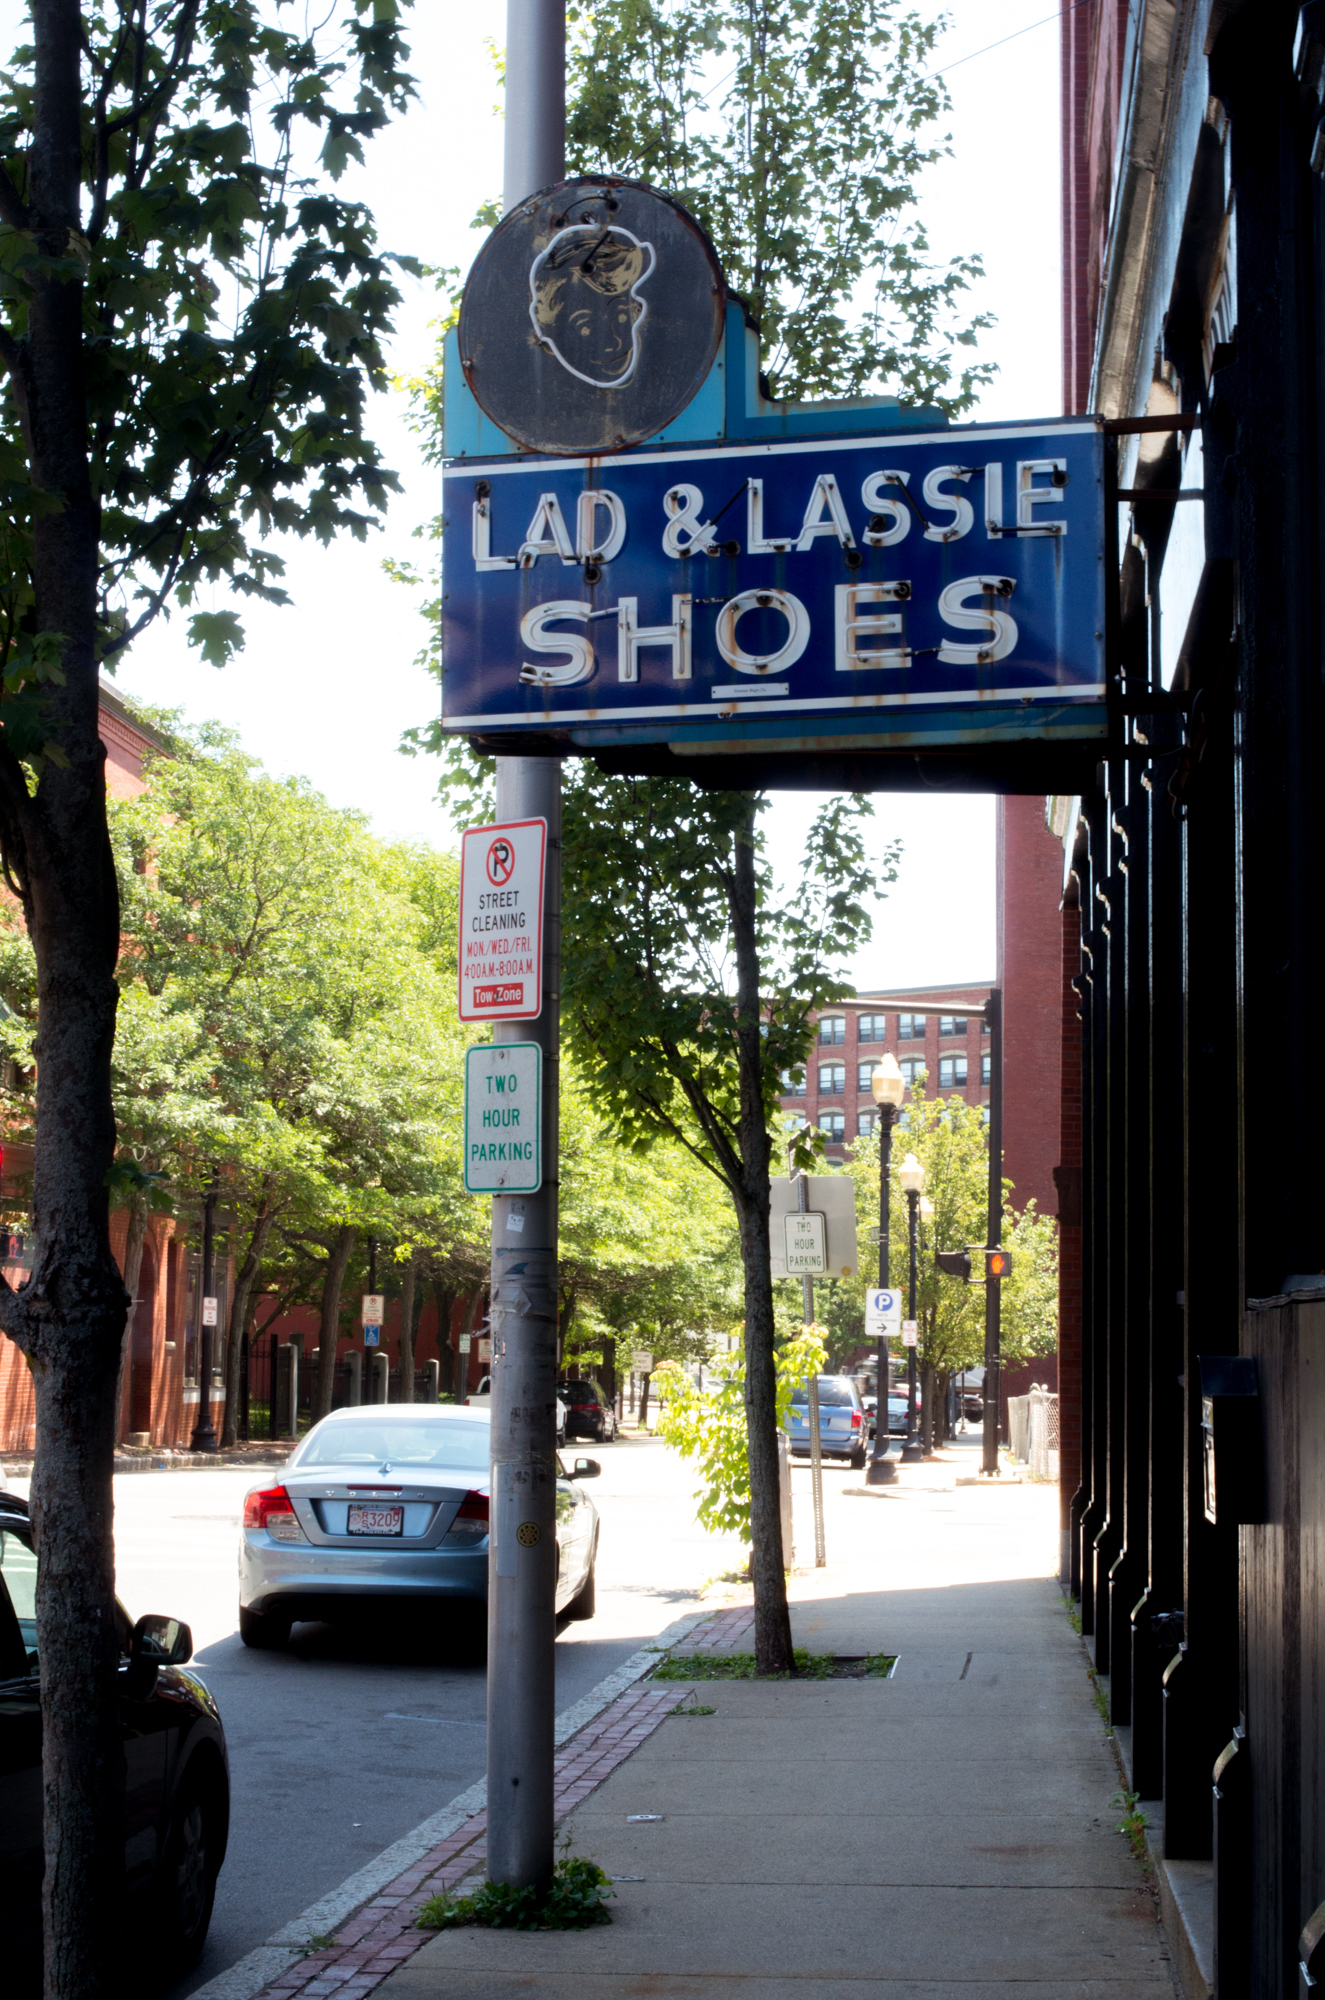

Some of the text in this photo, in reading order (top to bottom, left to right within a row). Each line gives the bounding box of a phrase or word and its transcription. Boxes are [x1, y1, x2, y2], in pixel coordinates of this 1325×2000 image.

[472, 458, 1067, 572] LAD & LASSIE
[519, 575, 1018, 686] SHOES
[479, 890, 519, 909] STREET
[472, 912, 526, 932] CLEANING
[475, 987, 521, 1004] Tow Zone
[486, 1074, 517, 1094] TWO
[482, 1108, 520, 1127] HOUR
[471, 1142, 533, 1161] PARKING
[797, 1222, 811, 1232] TWO
[794, 1239, 815, 1249] HOUR
[789, 1256, 822, 1266] PARKING
[326, 1490, 424, 1498] VOLVO
[369, 1512, 400, 1527] 3209
